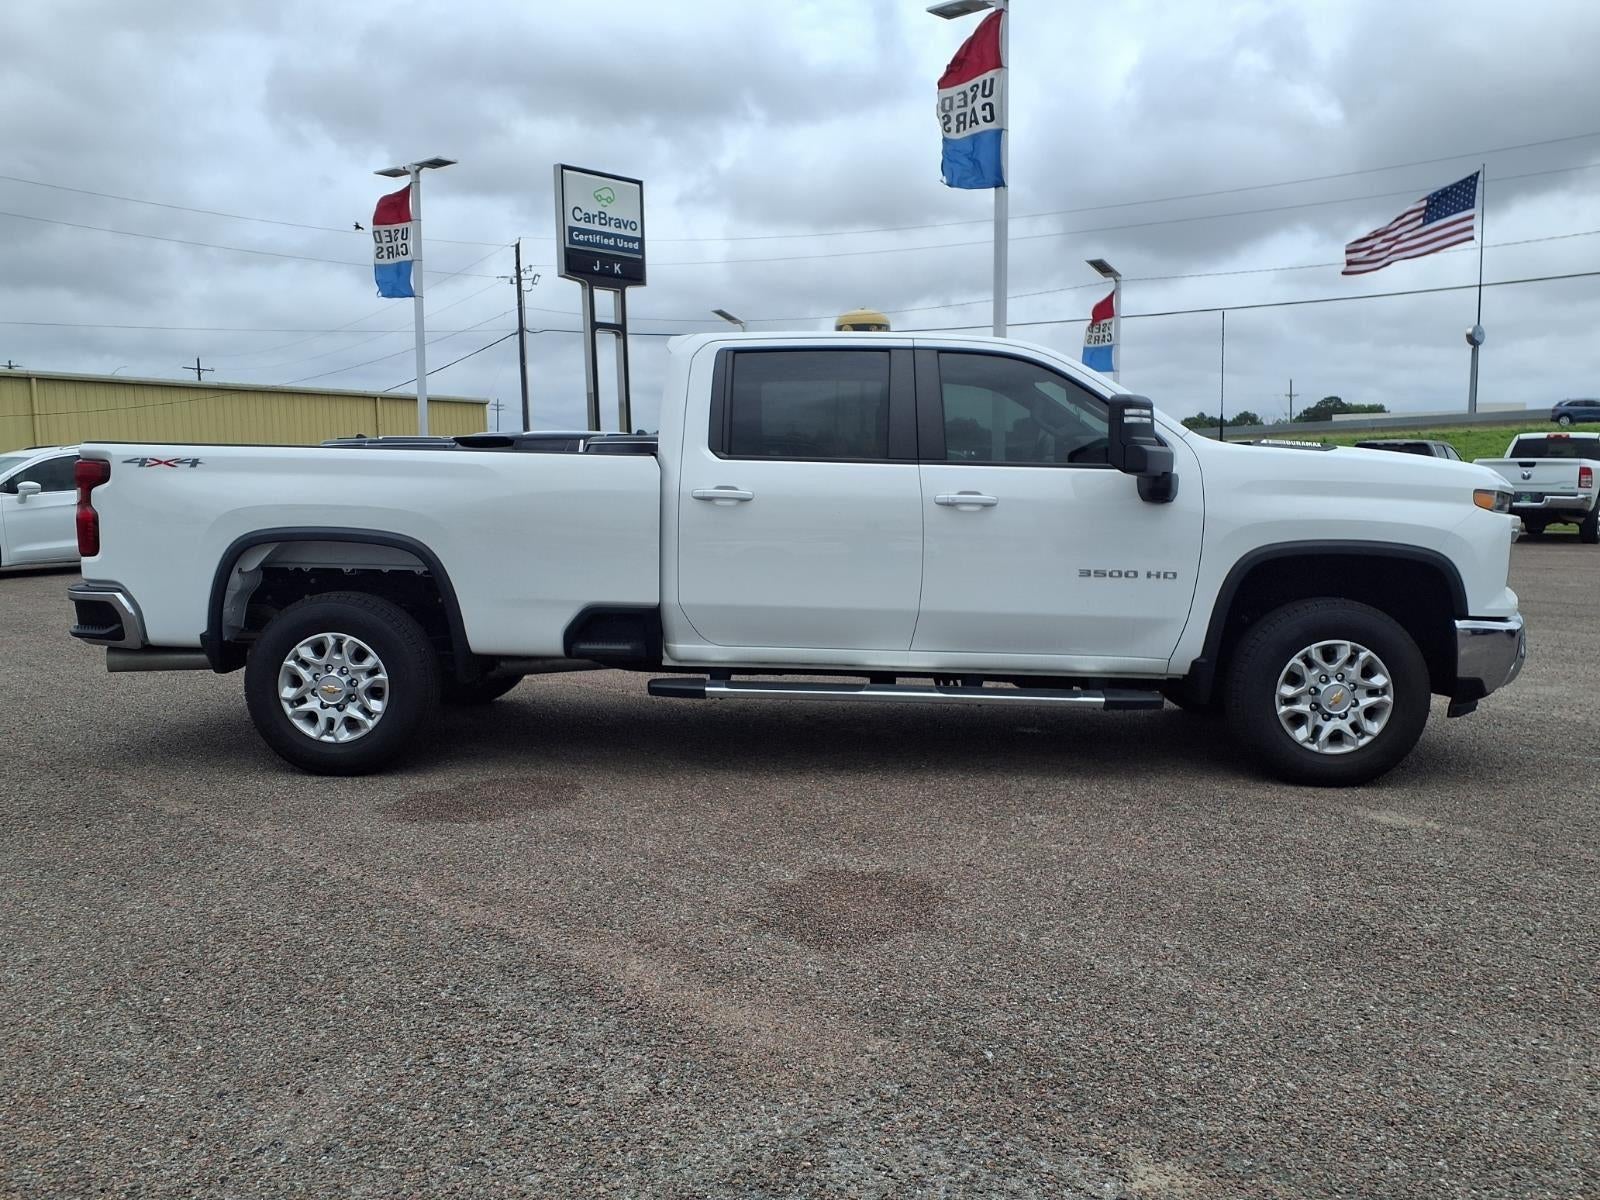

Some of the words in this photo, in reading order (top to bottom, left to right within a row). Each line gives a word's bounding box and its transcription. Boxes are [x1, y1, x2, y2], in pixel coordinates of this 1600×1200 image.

[571, 206, 638, 232] CarBravo
[572, 231, 615, 246] Certified
[616, 238, 639, 250] Used
[593, 260, 600, 271] J
[614, 263, 622, 274] K
[1078, 568, 1139, 579] 3500
[1146, 570, 1178, 580] HD
